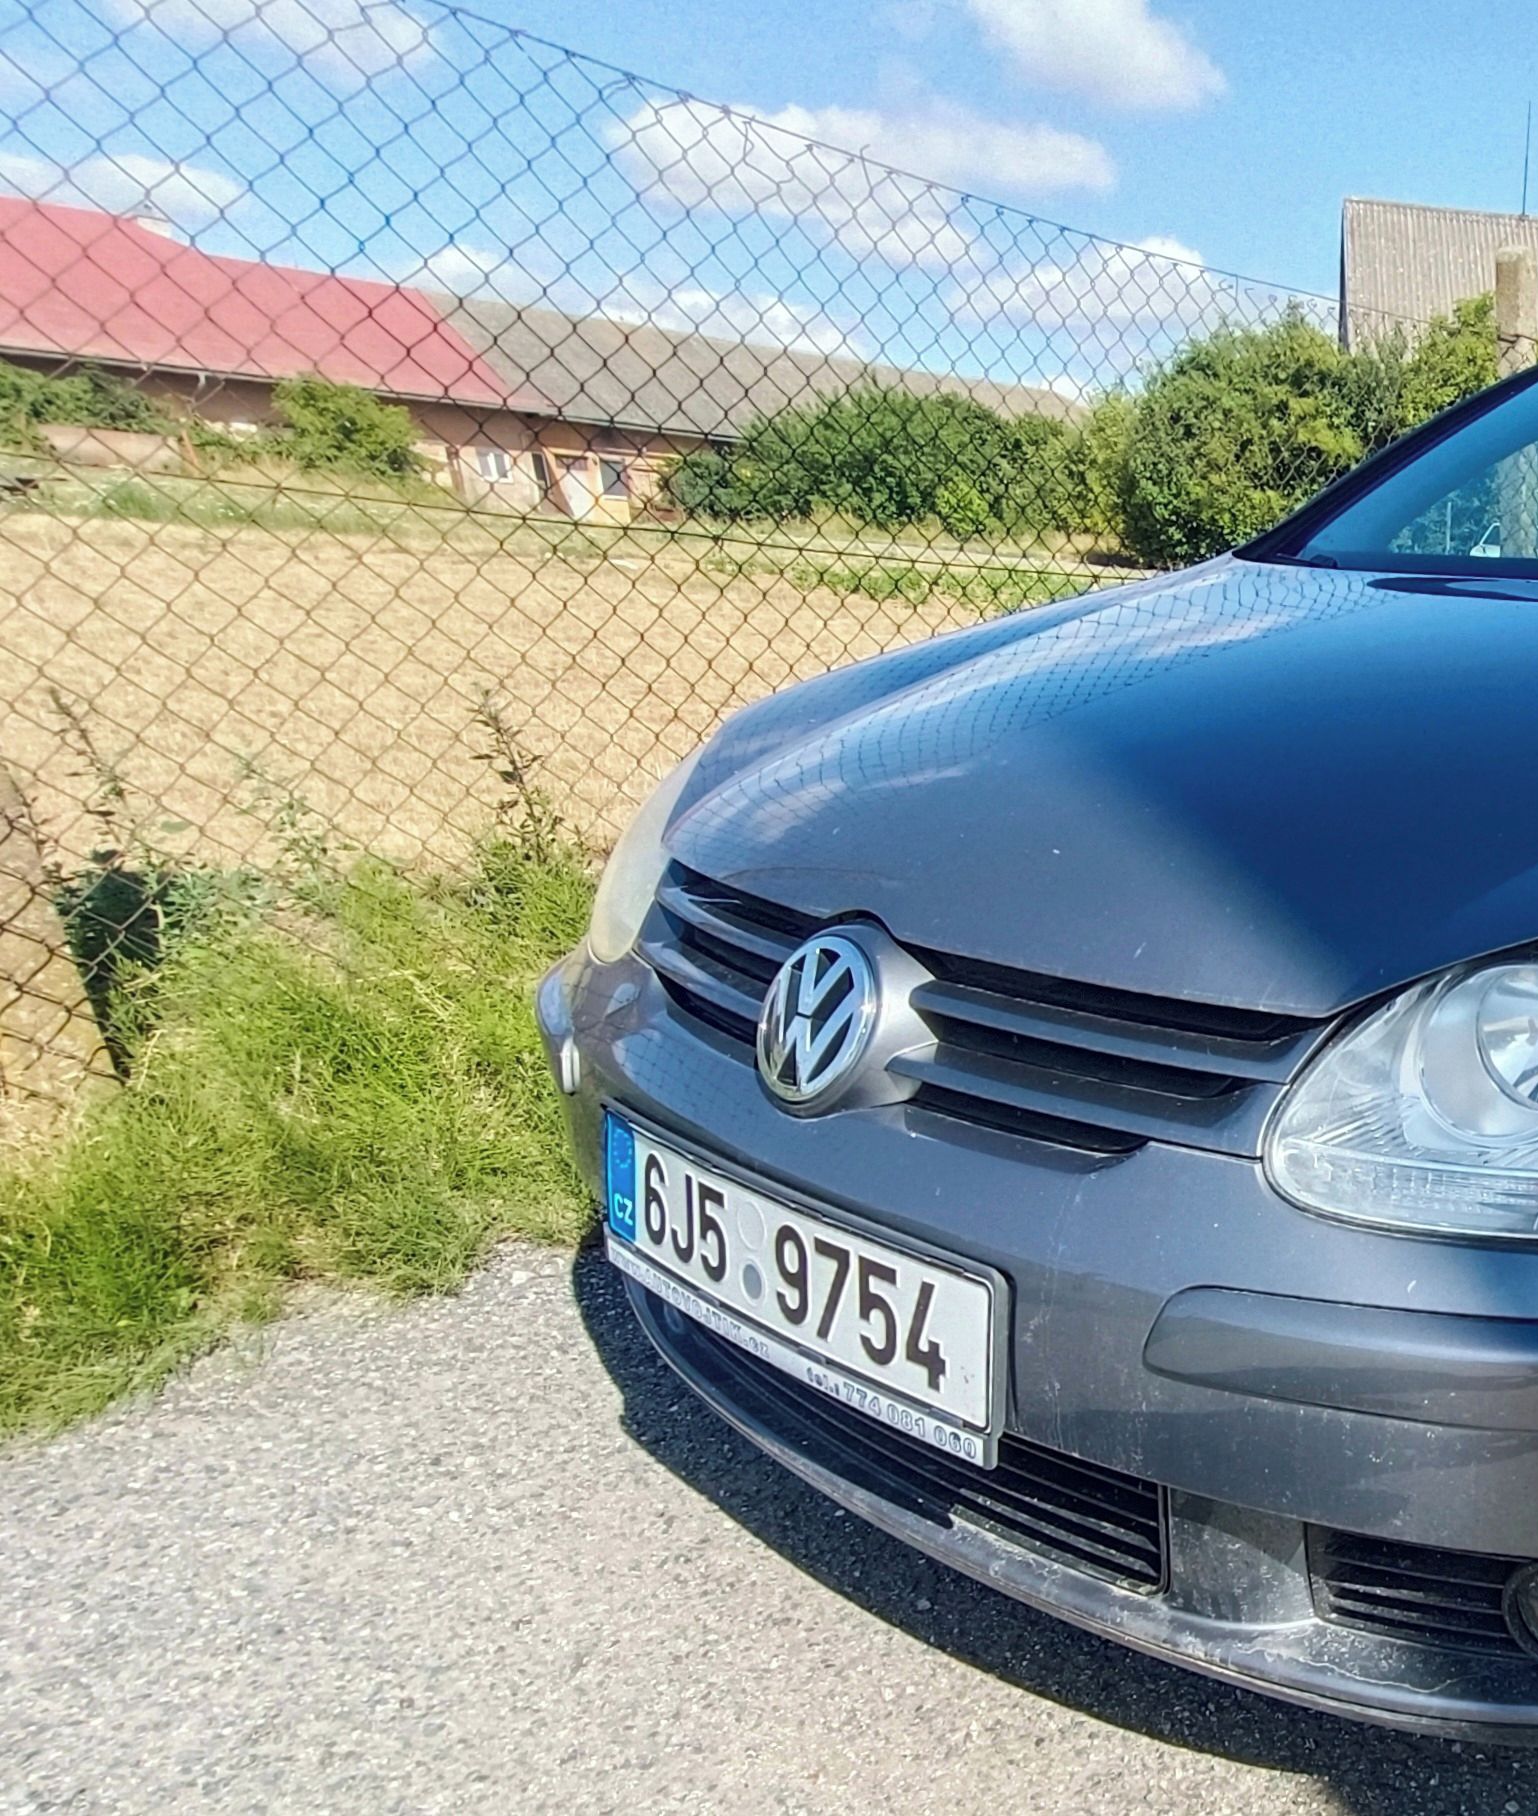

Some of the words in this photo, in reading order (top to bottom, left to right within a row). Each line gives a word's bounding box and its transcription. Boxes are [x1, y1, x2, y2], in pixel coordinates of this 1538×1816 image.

[613, 1192, 634, 1227] CZ
[644, 1152, 728, 1284] 6J5
[775, 1223, 948, 1393] 9754
[843, 1381, 882, 1416] 774
[887, 1403, 926, 1438] 081
[934, 1425, 977, 1460] 060
